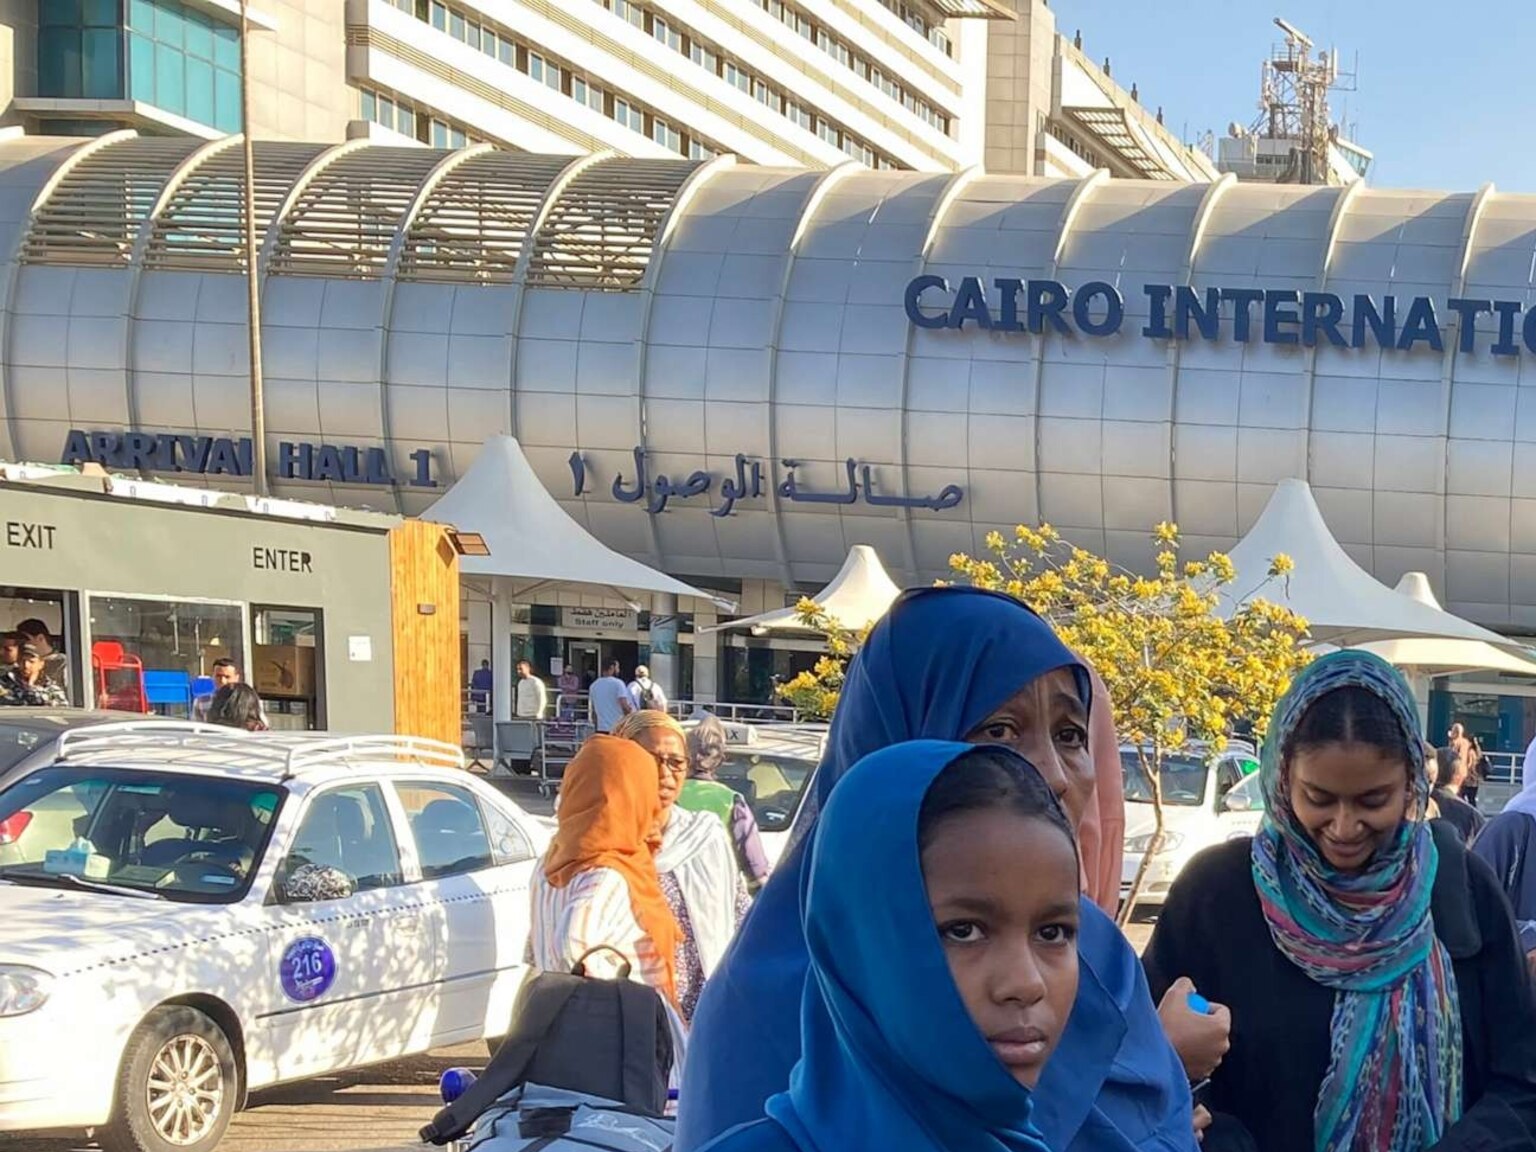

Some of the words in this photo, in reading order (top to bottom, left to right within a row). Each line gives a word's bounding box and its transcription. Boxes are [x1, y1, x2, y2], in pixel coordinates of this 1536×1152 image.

[904, 274, 1126, 337] CAIRO
[279, 441, 395, 483] HALL
[409, 449, 437, 488] 1
[612, 446, 761, 517] الوصول
[778, 458, 963, 511] صالة
[7, 522, 56, 550] EXIT
[252, 547, 313, 573] ENTER
[291, 951, 322, 980] 216
